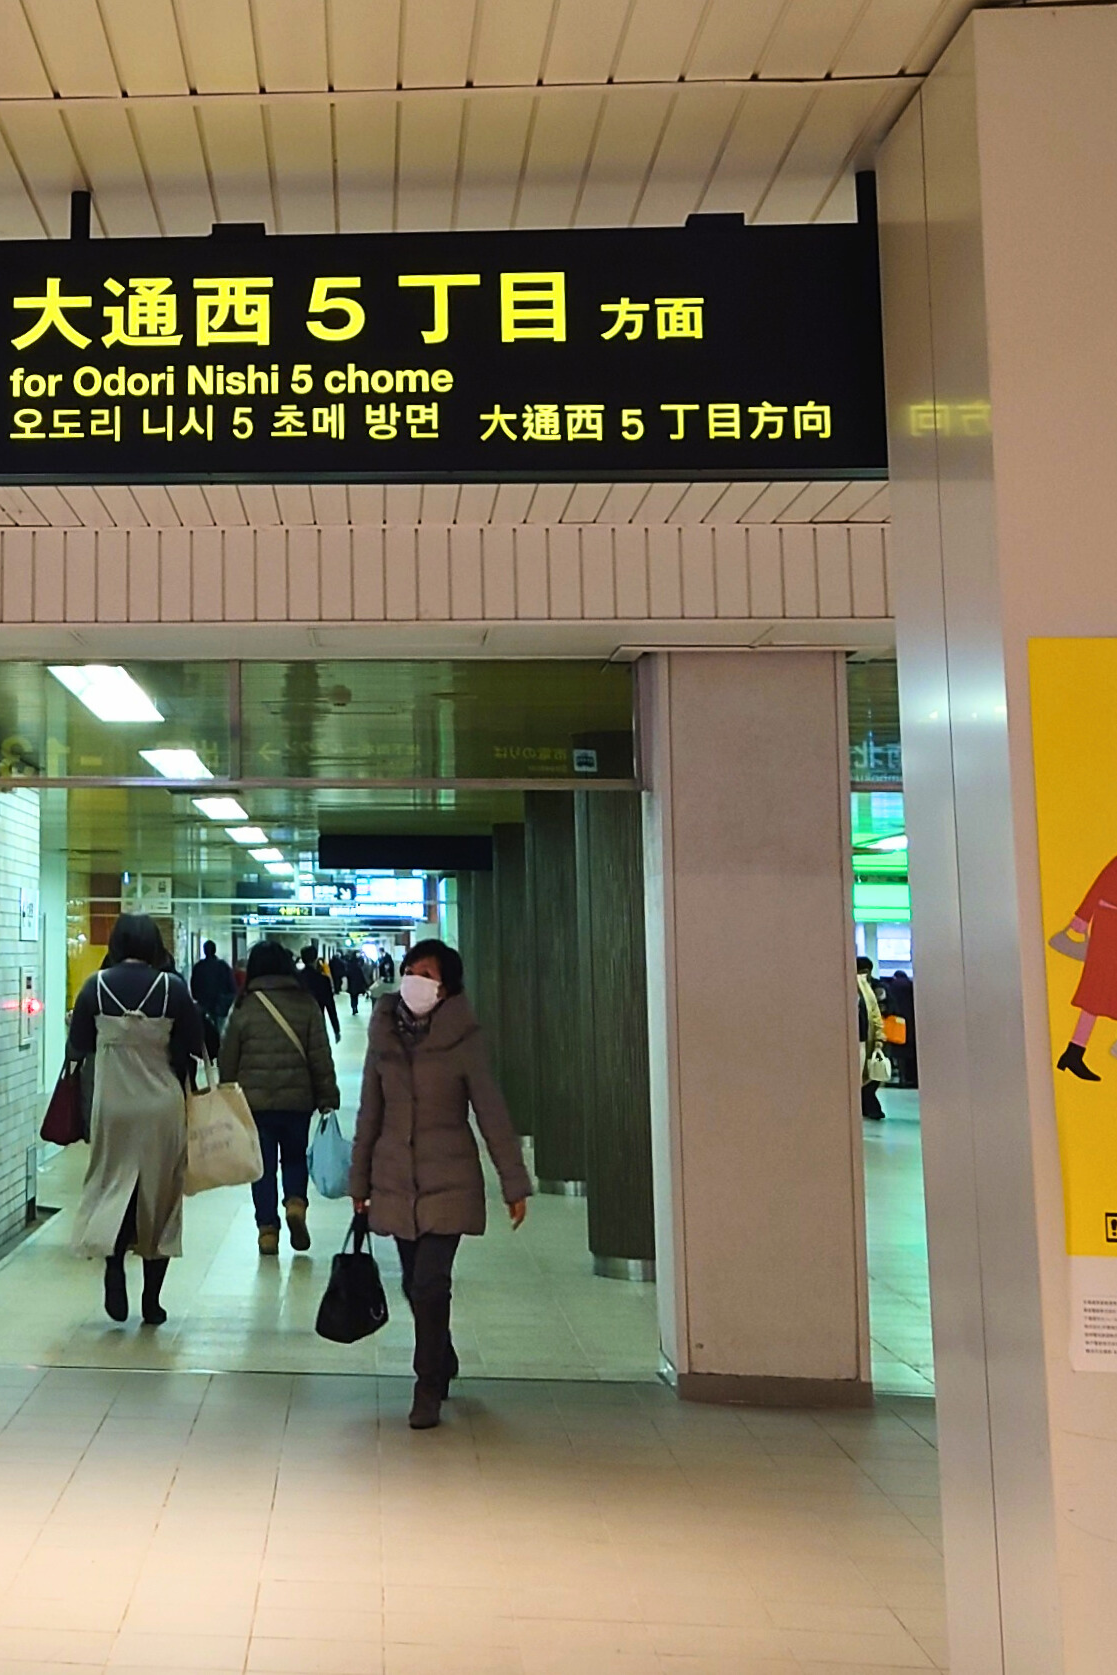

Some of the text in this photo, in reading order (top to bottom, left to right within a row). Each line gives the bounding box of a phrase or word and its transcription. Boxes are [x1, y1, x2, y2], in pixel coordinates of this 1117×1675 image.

[600, 297, 705, 341] 方面
[10, 363, 454, 397] for Odori Nishi 5 chome
[9, 402, 439, 442] 오도리 니시 5 초메 방면
